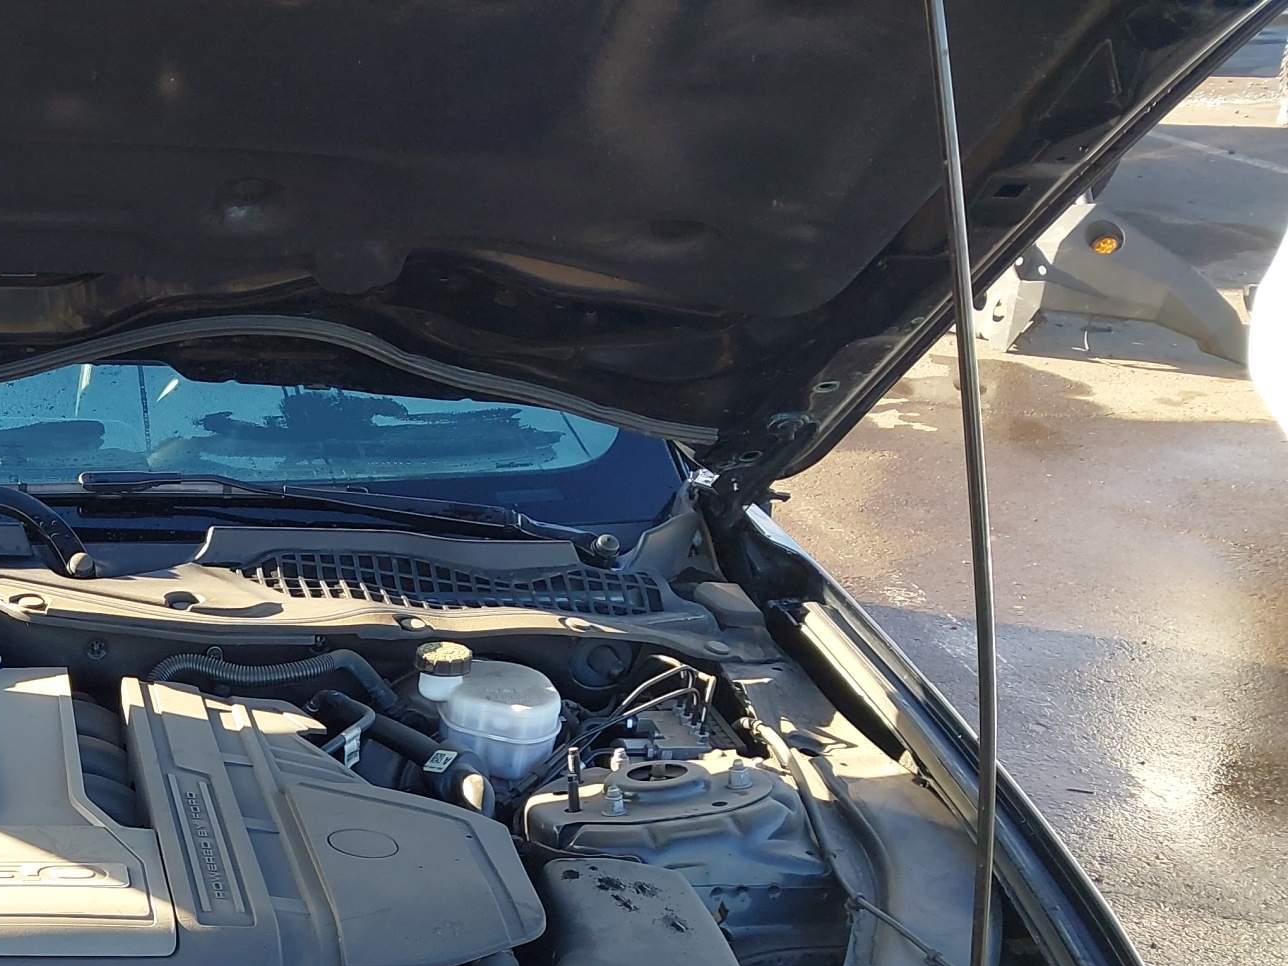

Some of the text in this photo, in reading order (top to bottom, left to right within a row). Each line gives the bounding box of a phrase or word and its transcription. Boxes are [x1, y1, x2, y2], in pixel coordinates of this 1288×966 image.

[185, 791, 225, 900] POWERED BY FORD
